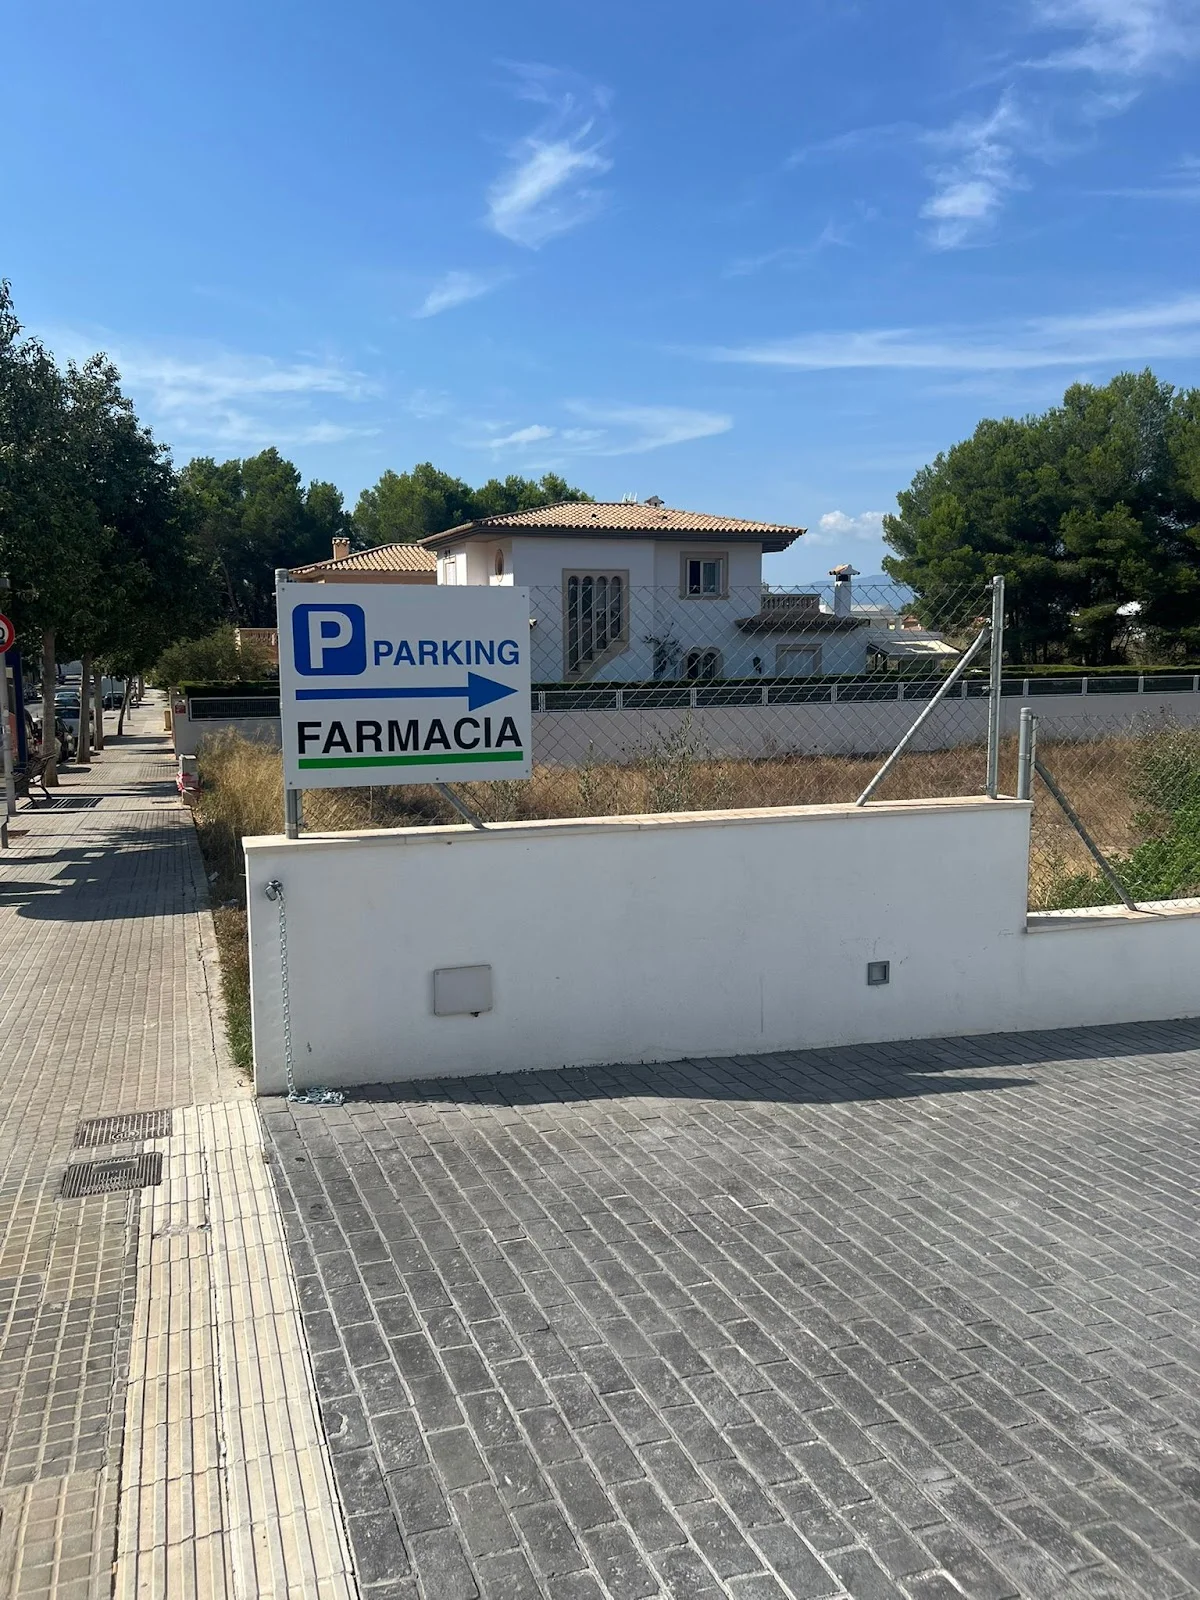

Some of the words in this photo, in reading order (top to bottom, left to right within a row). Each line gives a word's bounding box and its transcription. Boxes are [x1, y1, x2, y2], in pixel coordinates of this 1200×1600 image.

[308, 611, 353, 669] P
[373, 640, 519, 666] PARKING
[297, 717, 522, 754] FARMACIA
